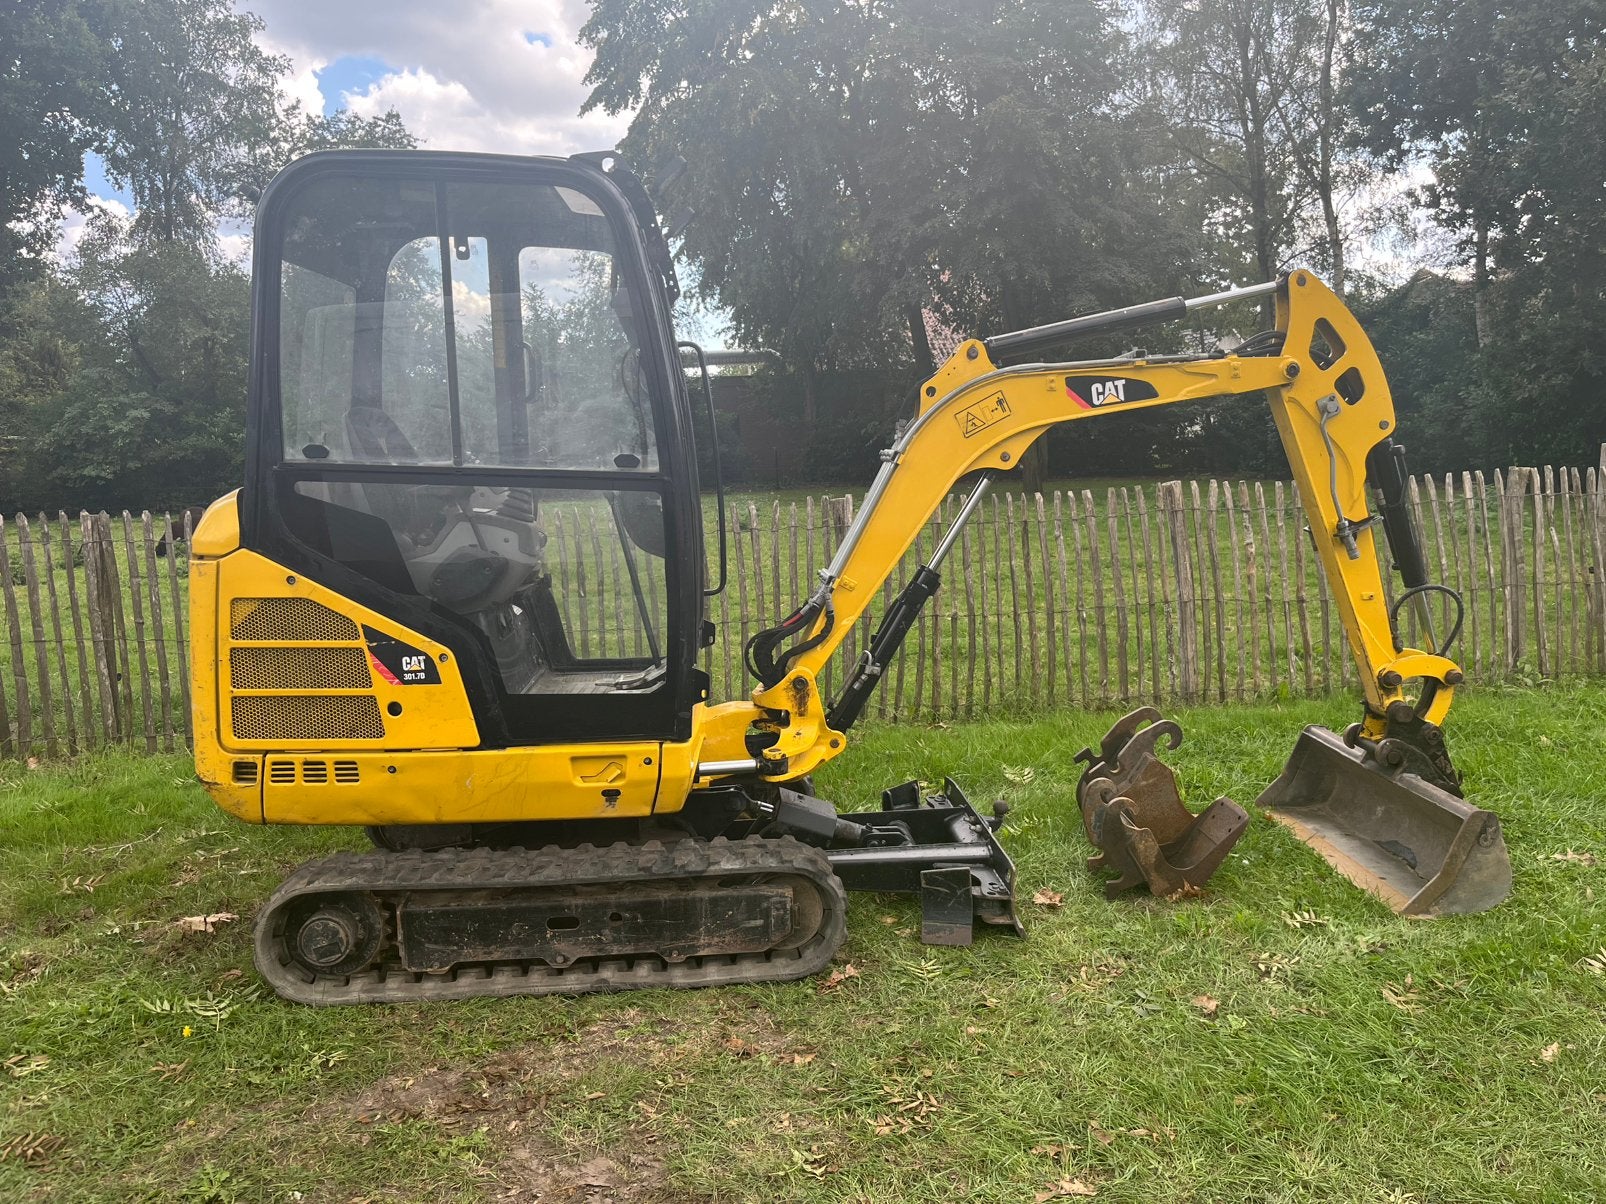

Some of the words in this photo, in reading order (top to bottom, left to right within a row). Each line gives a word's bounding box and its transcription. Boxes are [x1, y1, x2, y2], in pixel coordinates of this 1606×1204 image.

[1091, 379, 1126, 406] CAT
[402, 655, 426, 671] CAT
[403, 672, 426, 680] 301.7D
